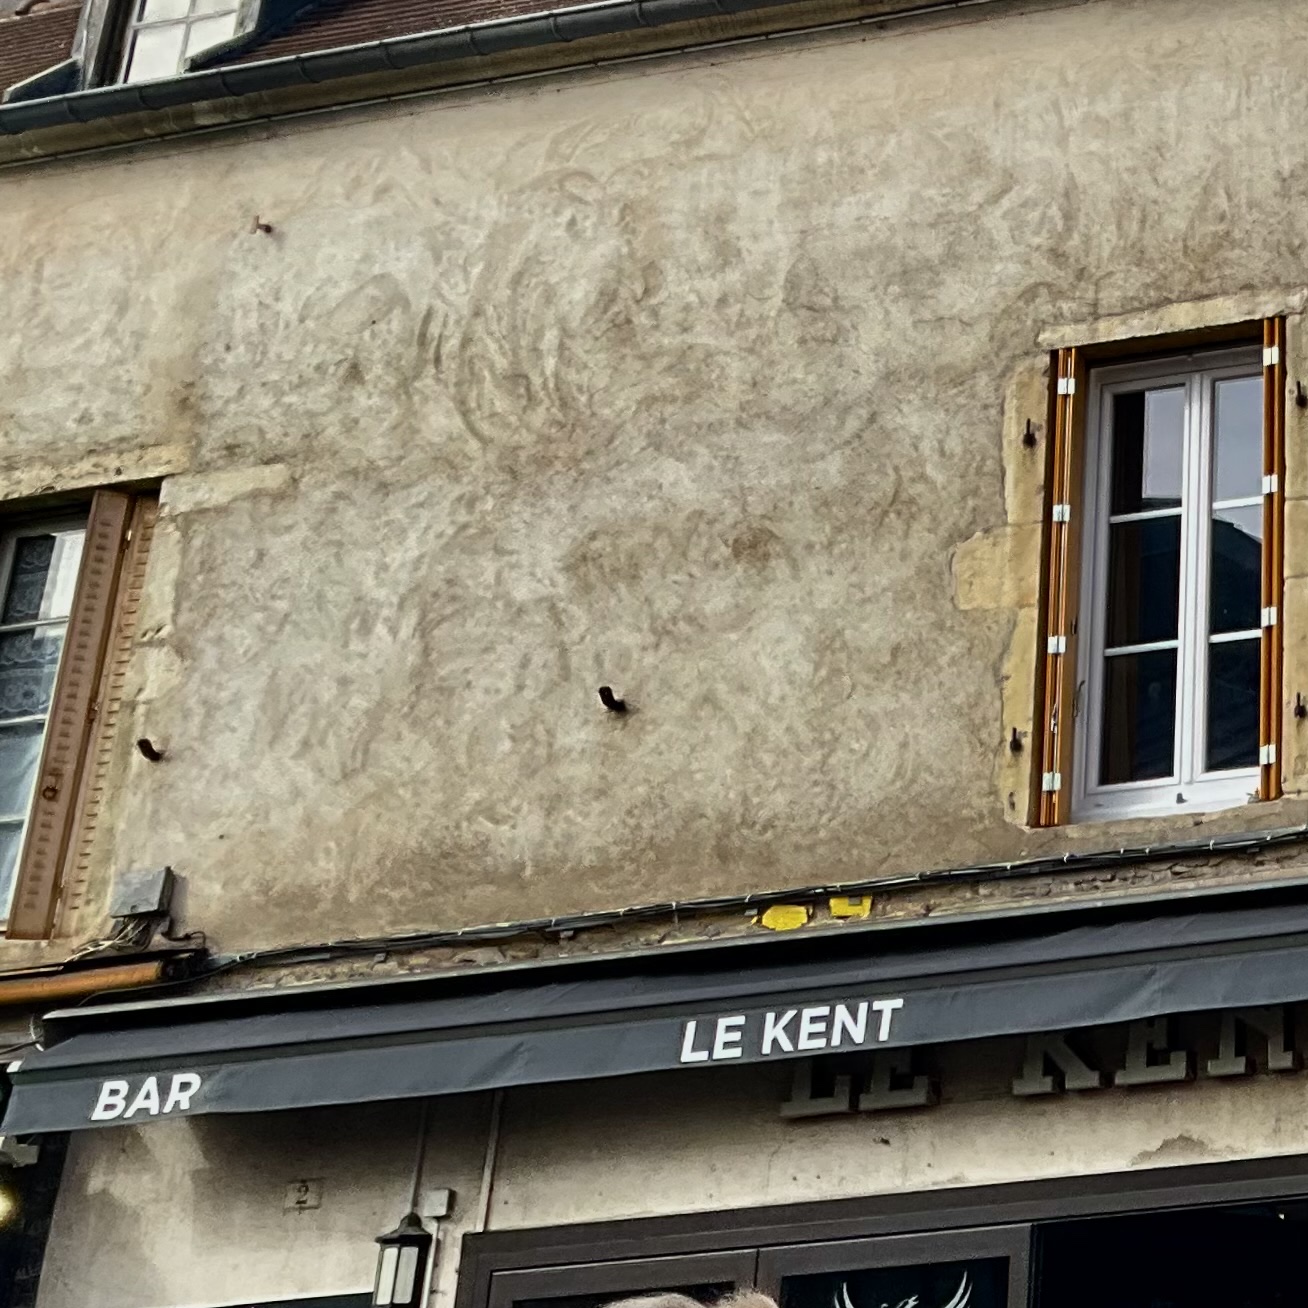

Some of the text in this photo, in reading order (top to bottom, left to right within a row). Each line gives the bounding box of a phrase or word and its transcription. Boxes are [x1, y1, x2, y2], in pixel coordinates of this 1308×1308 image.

[680, 998, 904, 1063] LE KENT
[90, 1073, 202, 1121] BAR
